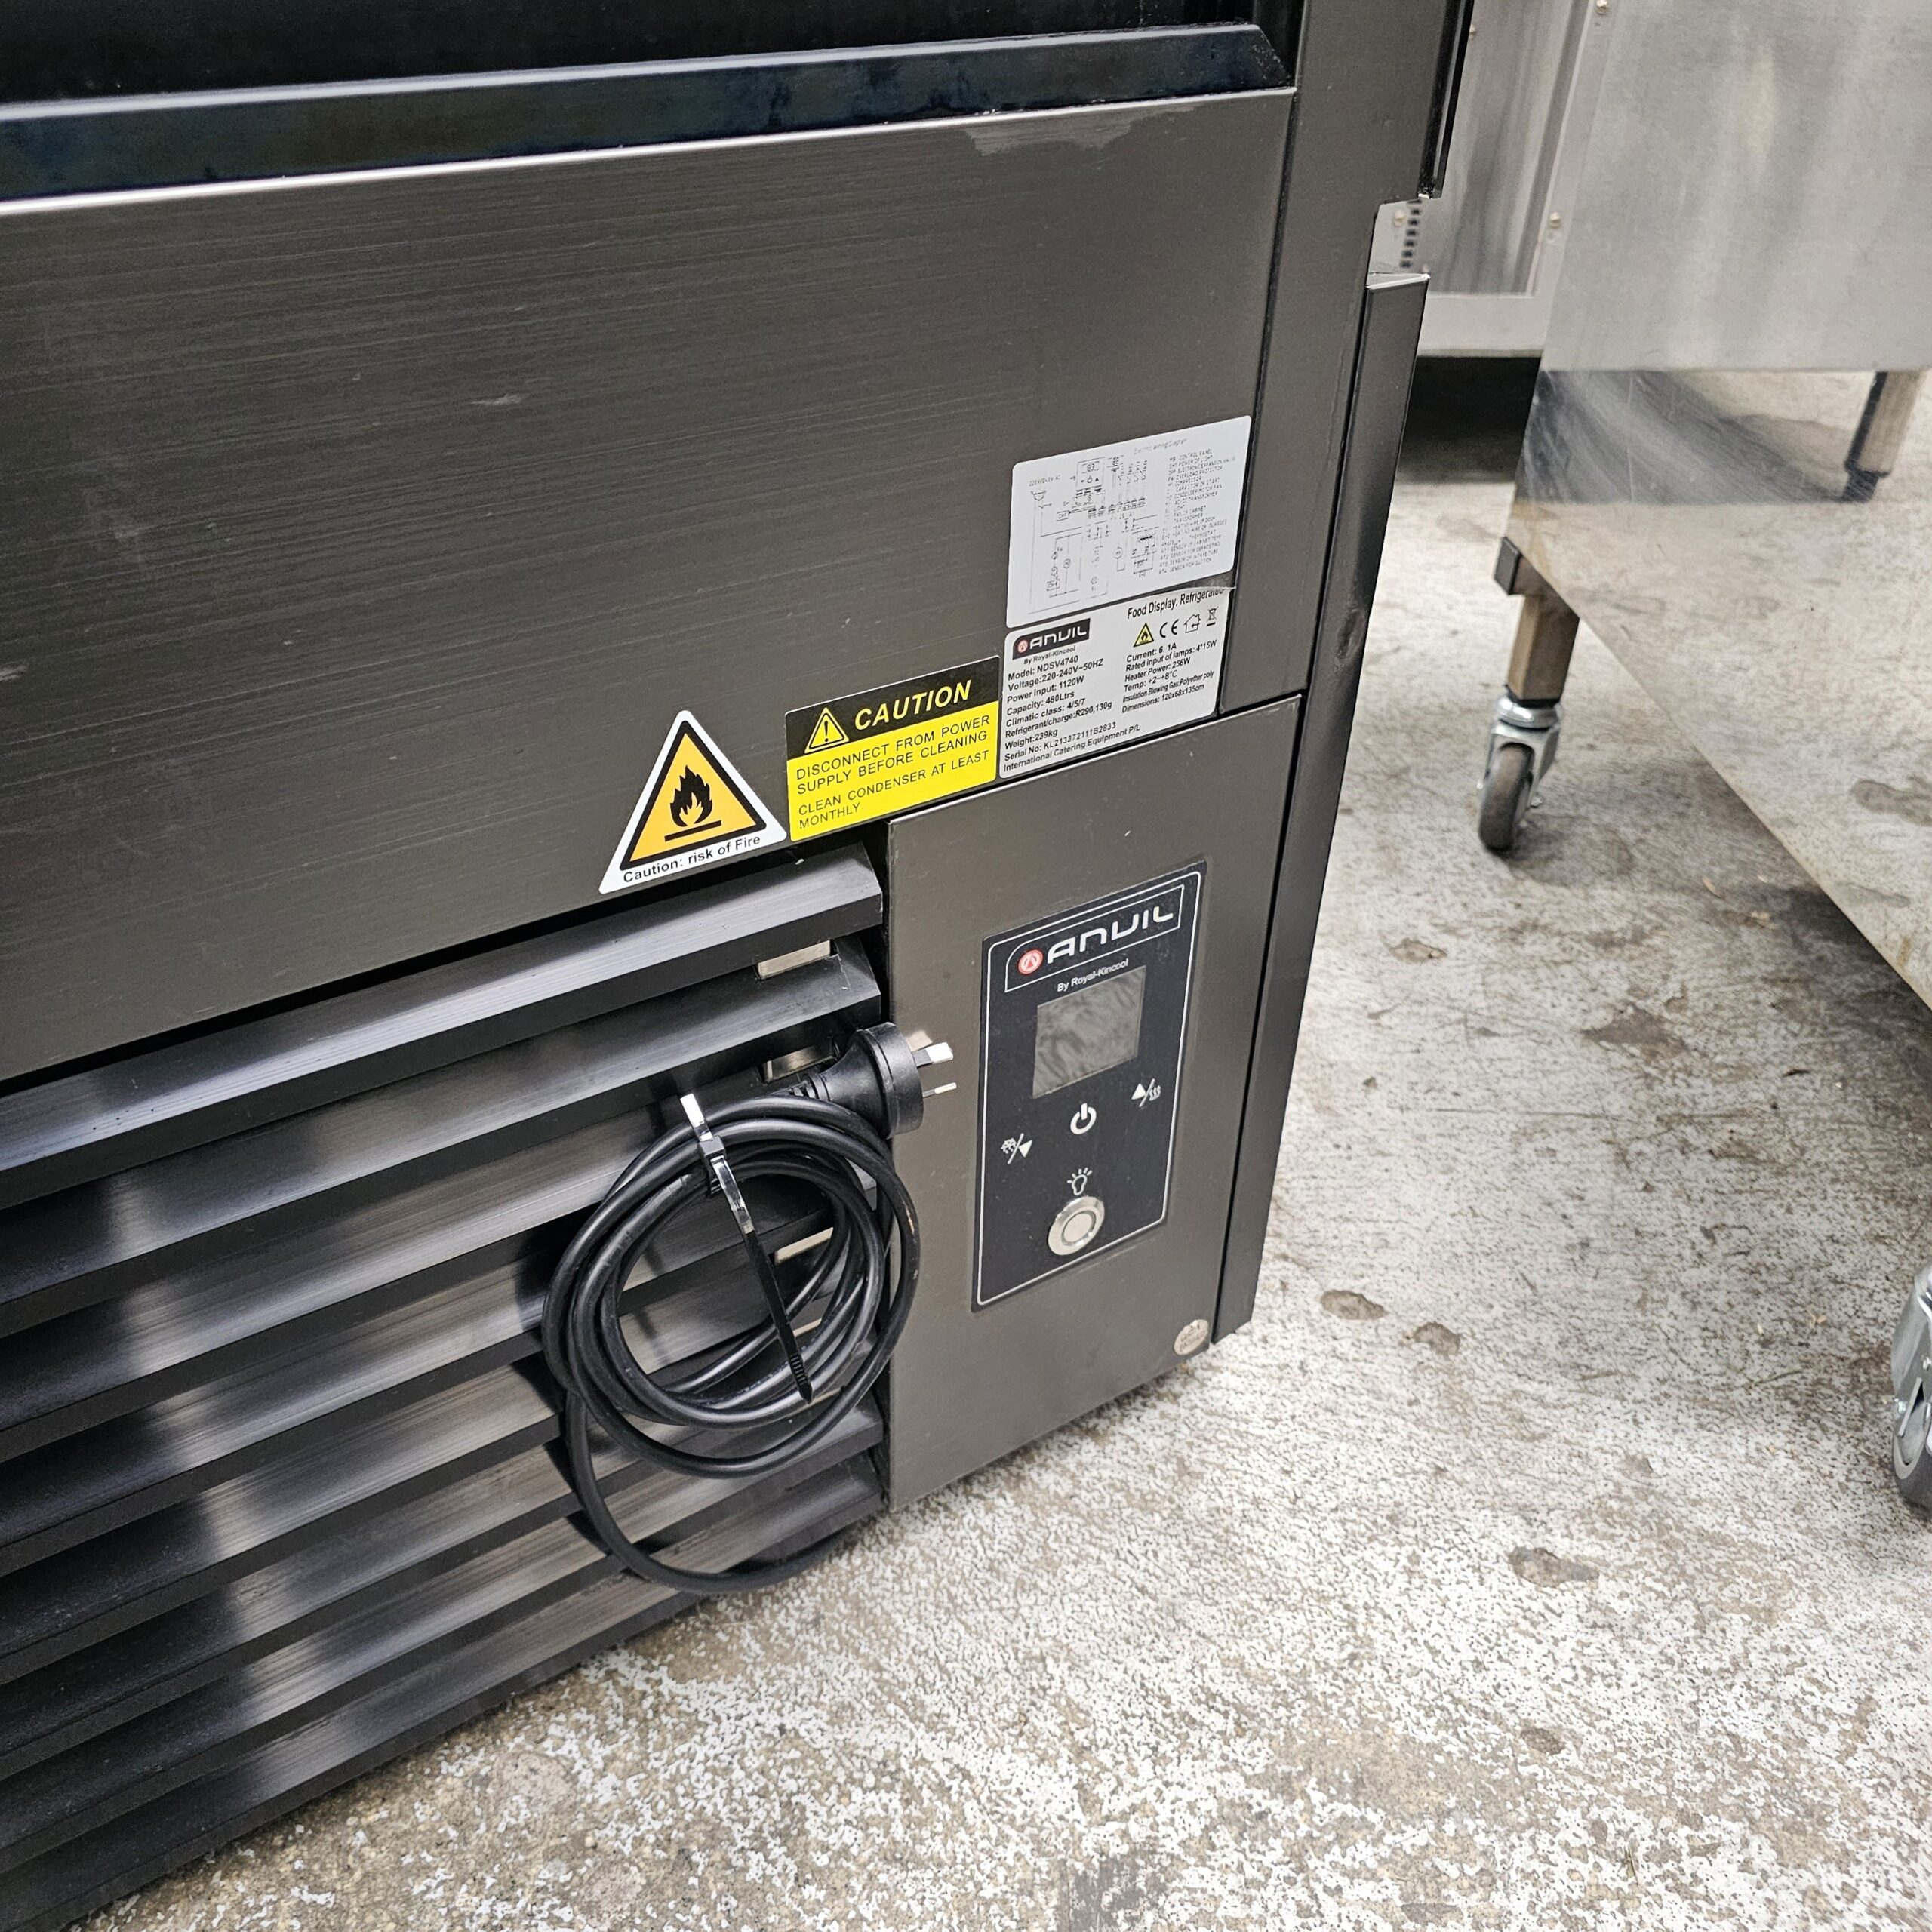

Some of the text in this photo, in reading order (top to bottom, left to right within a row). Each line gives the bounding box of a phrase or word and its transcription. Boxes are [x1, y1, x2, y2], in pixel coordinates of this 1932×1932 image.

[1128, 605, 1146, 620] Food
[1029, 625, 1087, 649] ANVIL
[1008, 655, 1079, 681] Model: NDSV4740
[1023, 646, 1076, 665] By Royal-Kincool
[1125, 659, 1146, 672] Rated
[1146, 654, 1164, 667] input
[1165, 652, 1172, 662] of
[1173, 647, 1195, 661] lamps:
[1126, 649, 1157, 663] Current:
[1124, 657, 1191, 683] Heater Power: 256W
[1007, 675, 1085, 704] Power input: 1120W
[1122, 690, 1147, 703] Insulation
[1148, 682, 1168, 699] Blowing
[1203, 669, 1214, 681] poly
[1124, 681, 1146, 692] Temp:
[854, 679, 972, 731] CAUTION
[1006, 697, 1086, 728] Climatic class: 4/5/7
[1007, 691, 1075, 716] Capacity: 480Ltrs
[1121, 697, 1160, 714] Dimensions:
[795, 714, 990, 781] DISCONNECT FROM POWER
[1004, 729, 1058, 750] Weight:239kg
[1004, 723, 1140, 772] International Catering Equipment P/L
[1004, 750, 1027, 761] Serial
[1028, 743, 1042, 754] No:
[796, 729, 989, 795] SUPPLY BEFORE CLEANING
[798, 749, 989, 816] CLEAN CONDENSER AT LEAST
[798, 801, 862, 830] MONTHLY
[623, 835, 761, 884] Caution: risk of Fire
[1047, 906, 1174, 964] ANVIL
[1057, 958, 1128, 993] By Royal-Kincool
